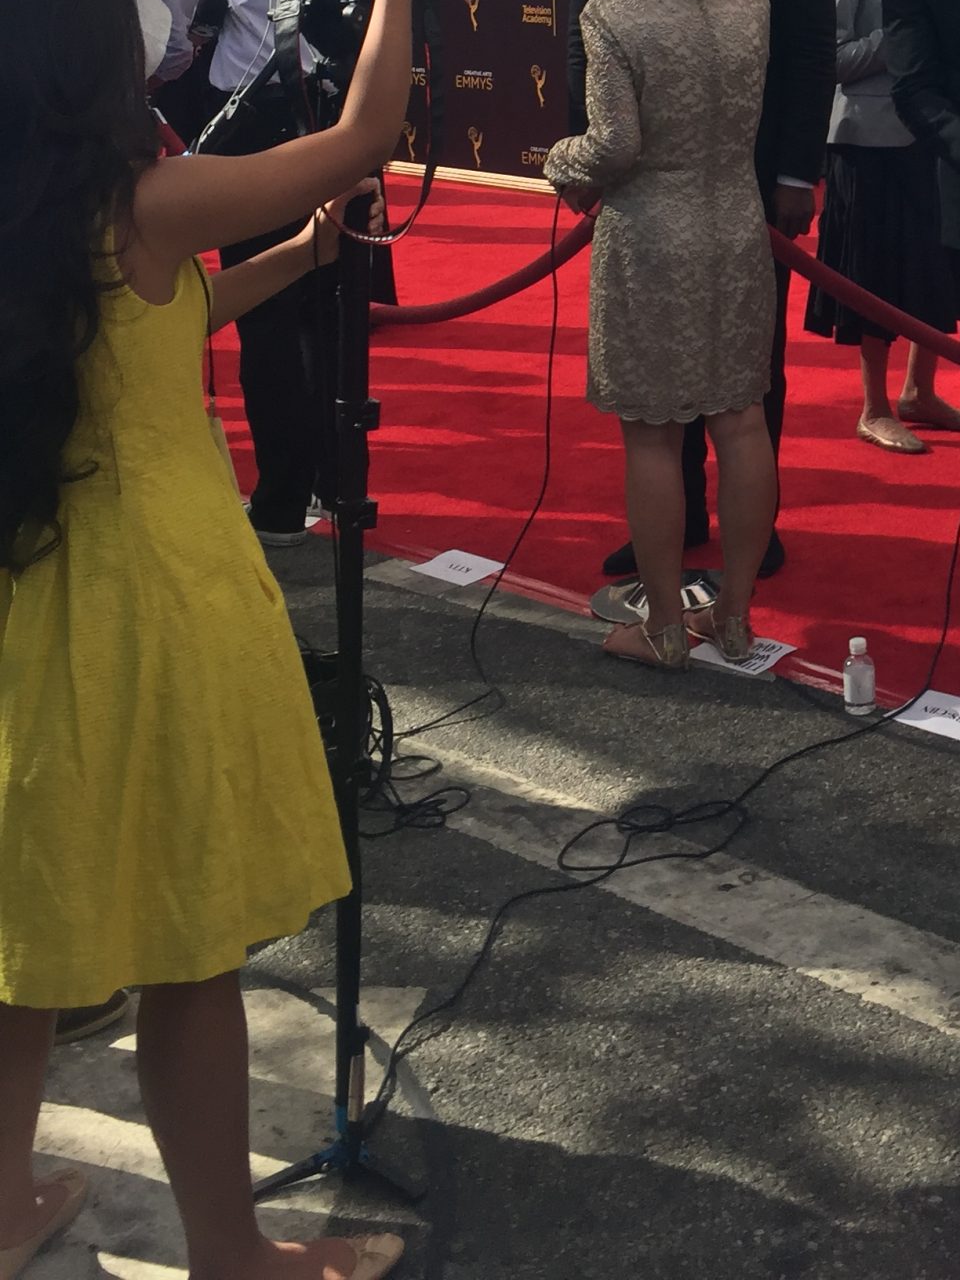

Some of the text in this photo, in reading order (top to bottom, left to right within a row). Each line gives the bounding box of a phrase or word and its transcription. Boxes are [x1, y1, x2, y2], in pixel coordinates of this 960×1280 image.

[522, 5, 552, 15] Television
[522, 14, 552, 26] Academy
[455, 75, 493, 90] EMMYS
